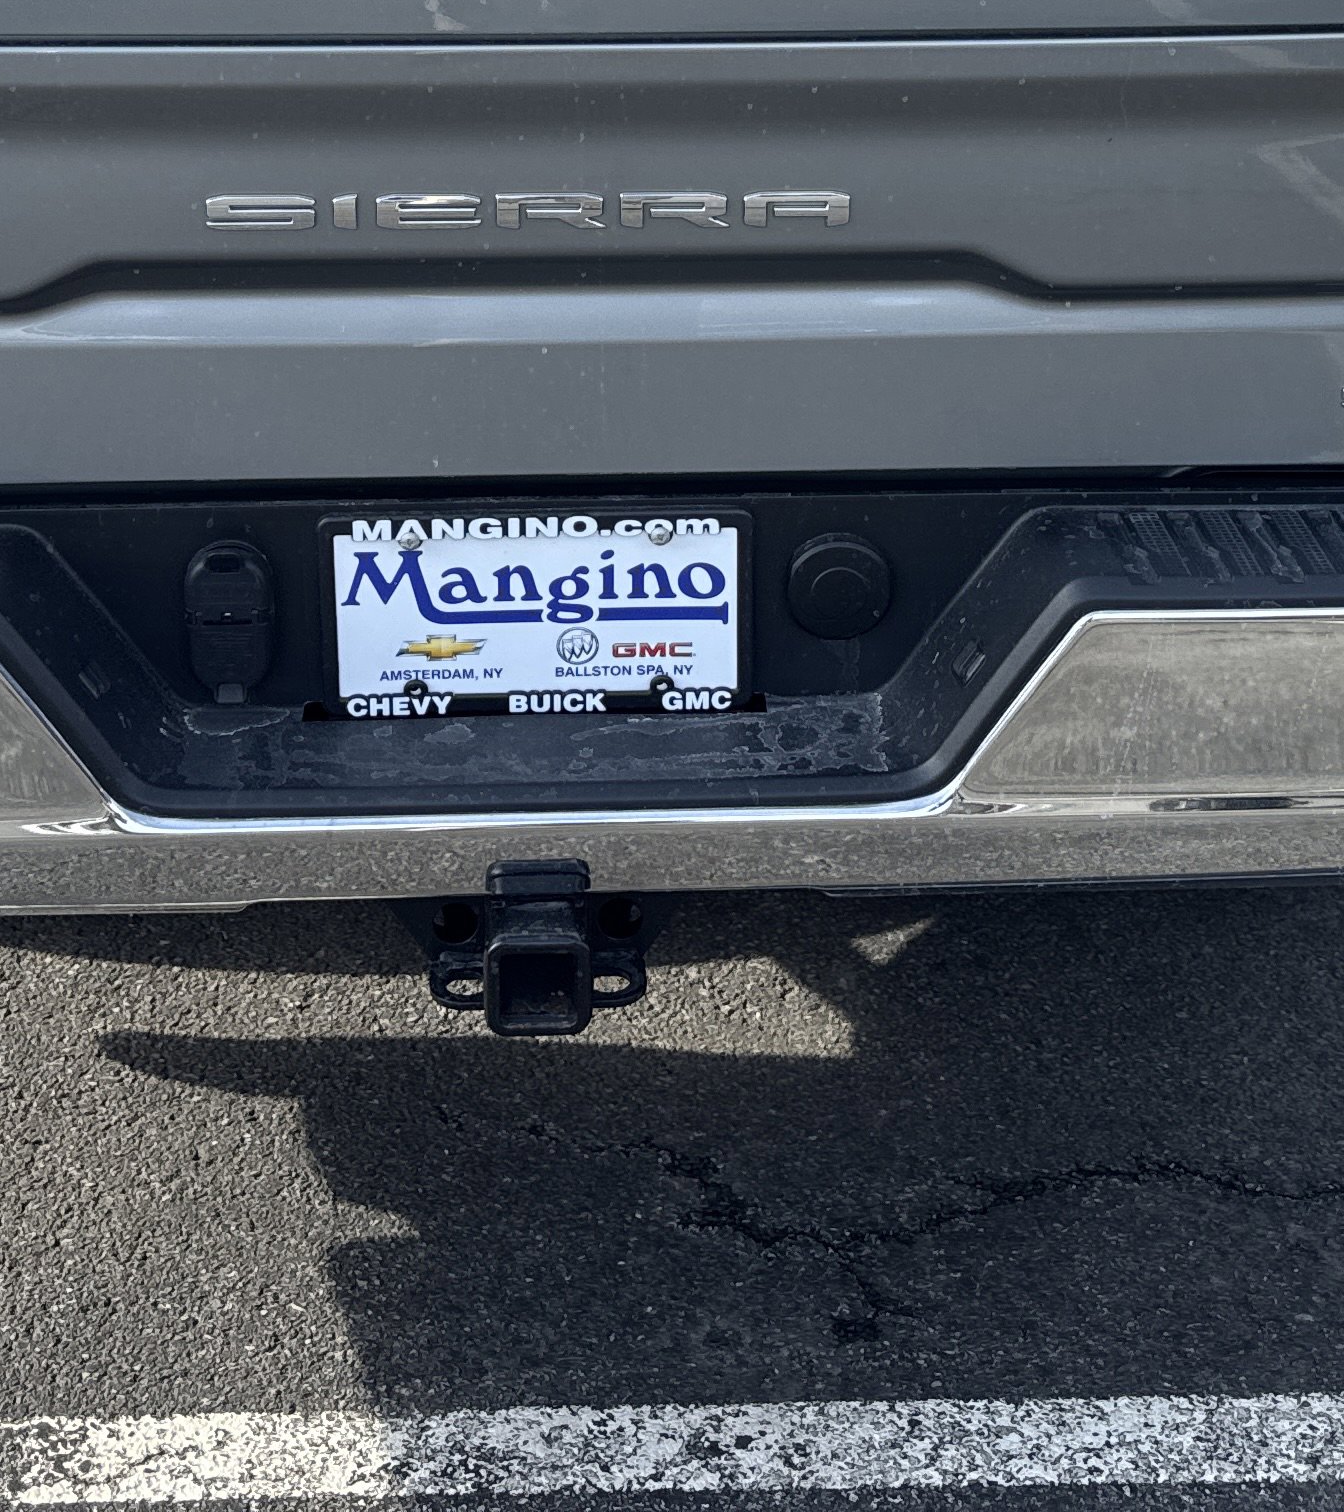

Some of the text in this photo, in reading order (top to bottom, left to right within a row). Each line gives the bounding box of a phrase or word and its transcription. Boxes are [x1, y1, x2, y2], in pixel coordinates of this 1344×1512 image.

[204, 190, 851, 231] SIERRA
[351, 515, 721, 541] MANGINO.com
[341, 549, 729, 625] Mangino
[611, 641, 695, 658] GMC
[379, 667, 503, 682] AMSTERDAM, NY
[554, 665, 693, 678] BALLSTON SPA, NY
[346, 690, 732, 718] CHEVY BUICK GMC
